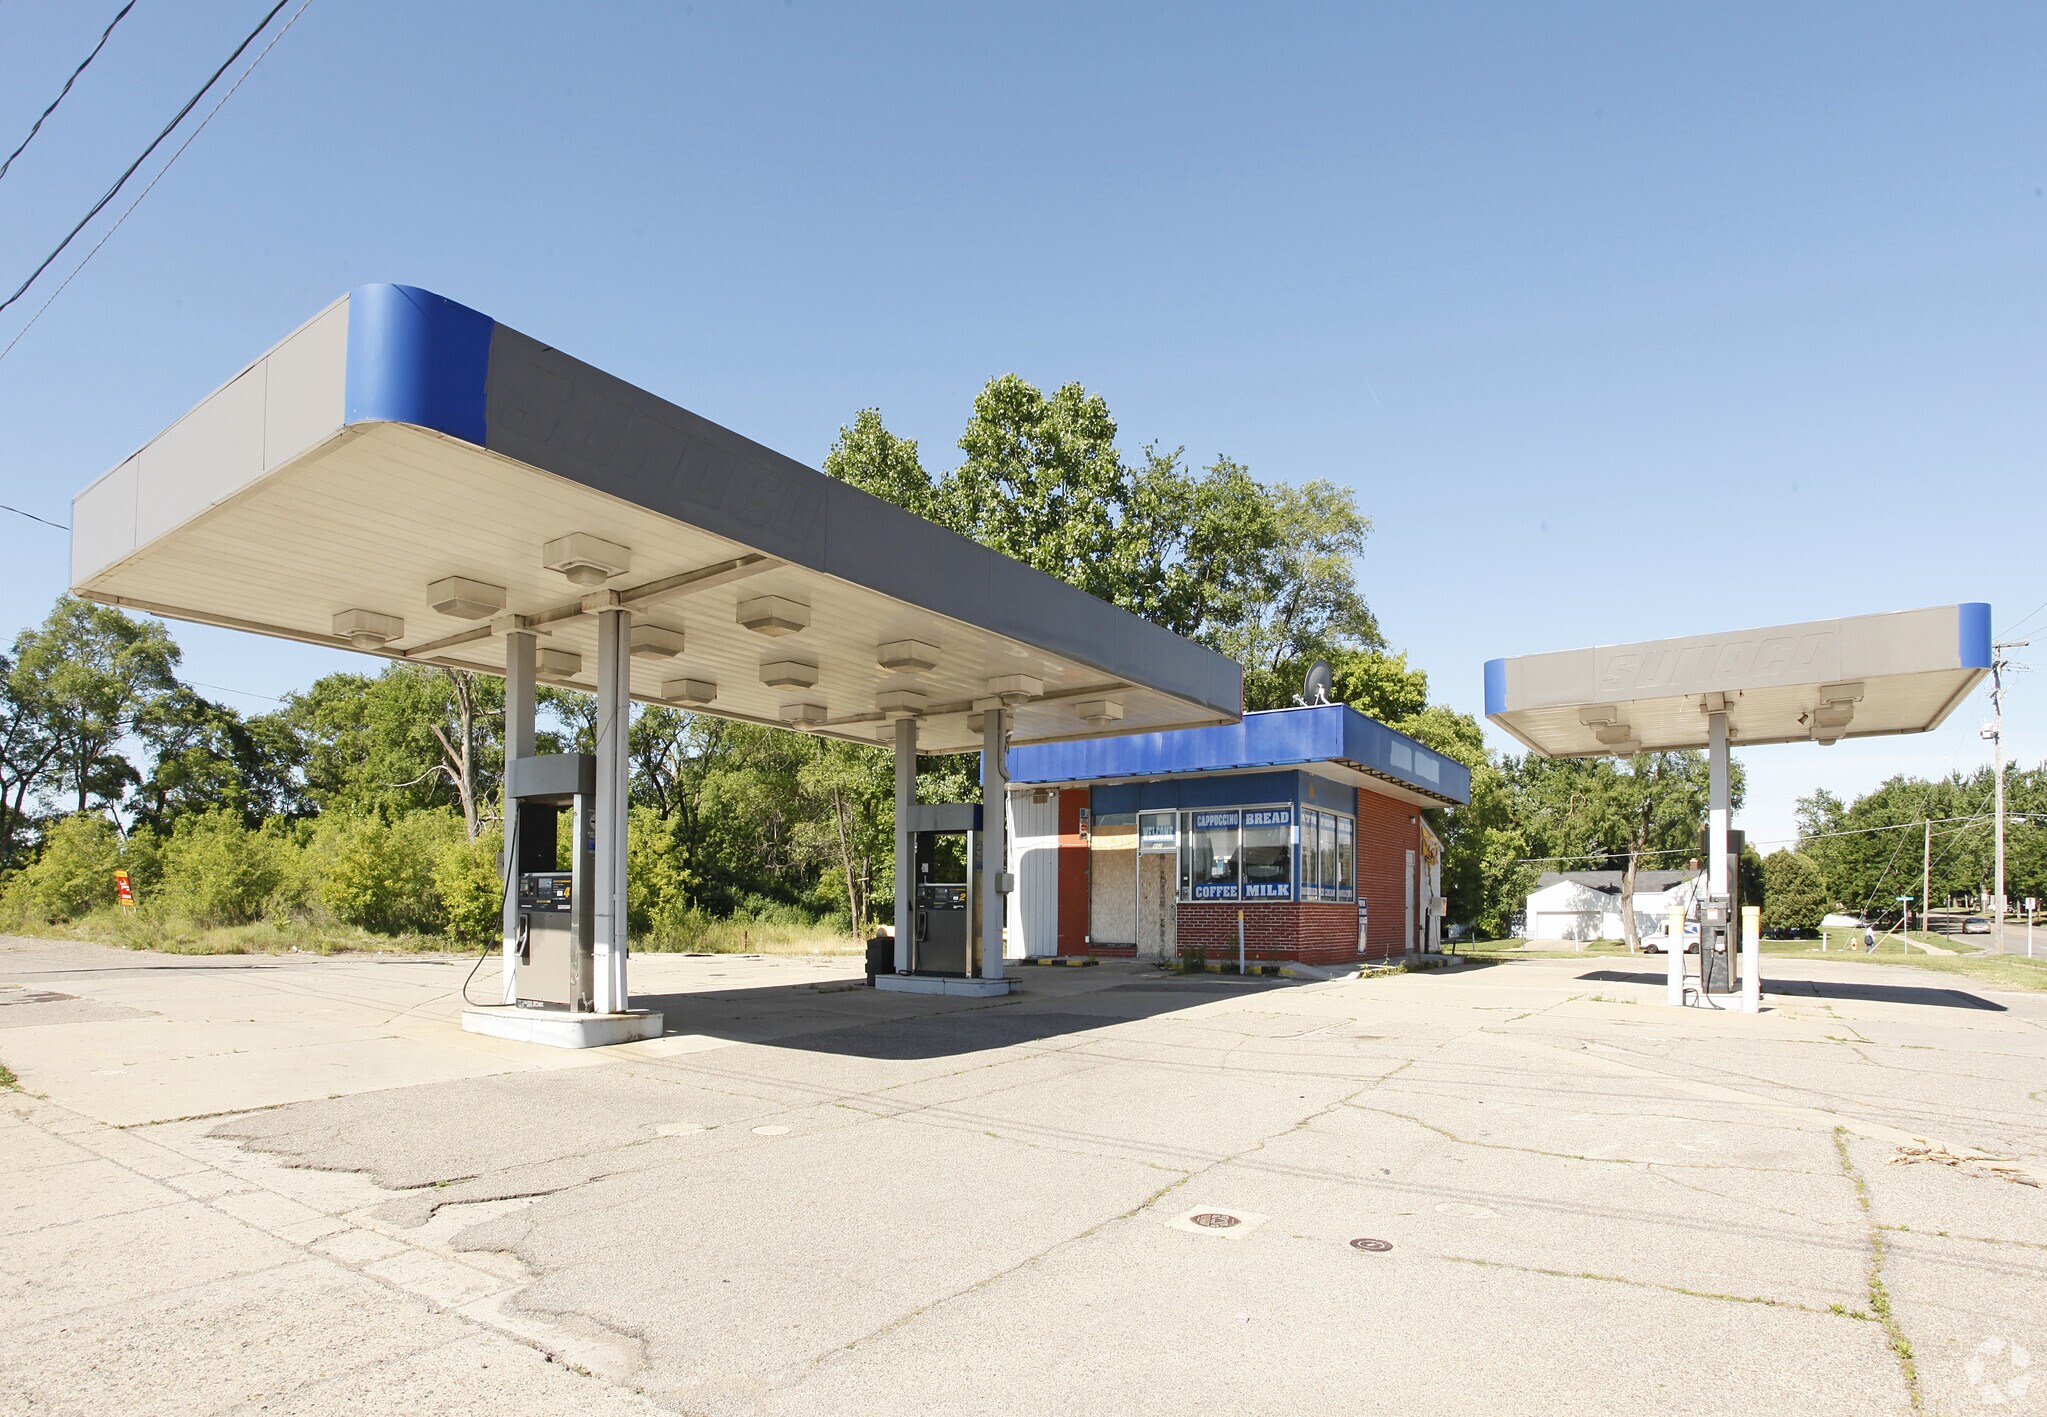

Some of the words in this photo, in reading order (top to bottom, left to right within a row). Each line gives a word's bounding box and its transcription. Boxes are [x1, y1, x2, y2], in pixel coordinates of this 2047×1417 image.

[1599, 631, 1835, 692] SUNOCO
[1197, 813, 1239, 826] CAPPUCCINO
[1245, 811, 1290, 825] BREAD
[1300, 813, 1317, 825] ATM
[1142, 825, 1174, 841] WELCOME
[563, 886, 571, 897] 4
[960, 893, 966, 901] 2
[1195, 885, 1238, 898] COFFEE
[1245, 884, 1290, 897] MILK
